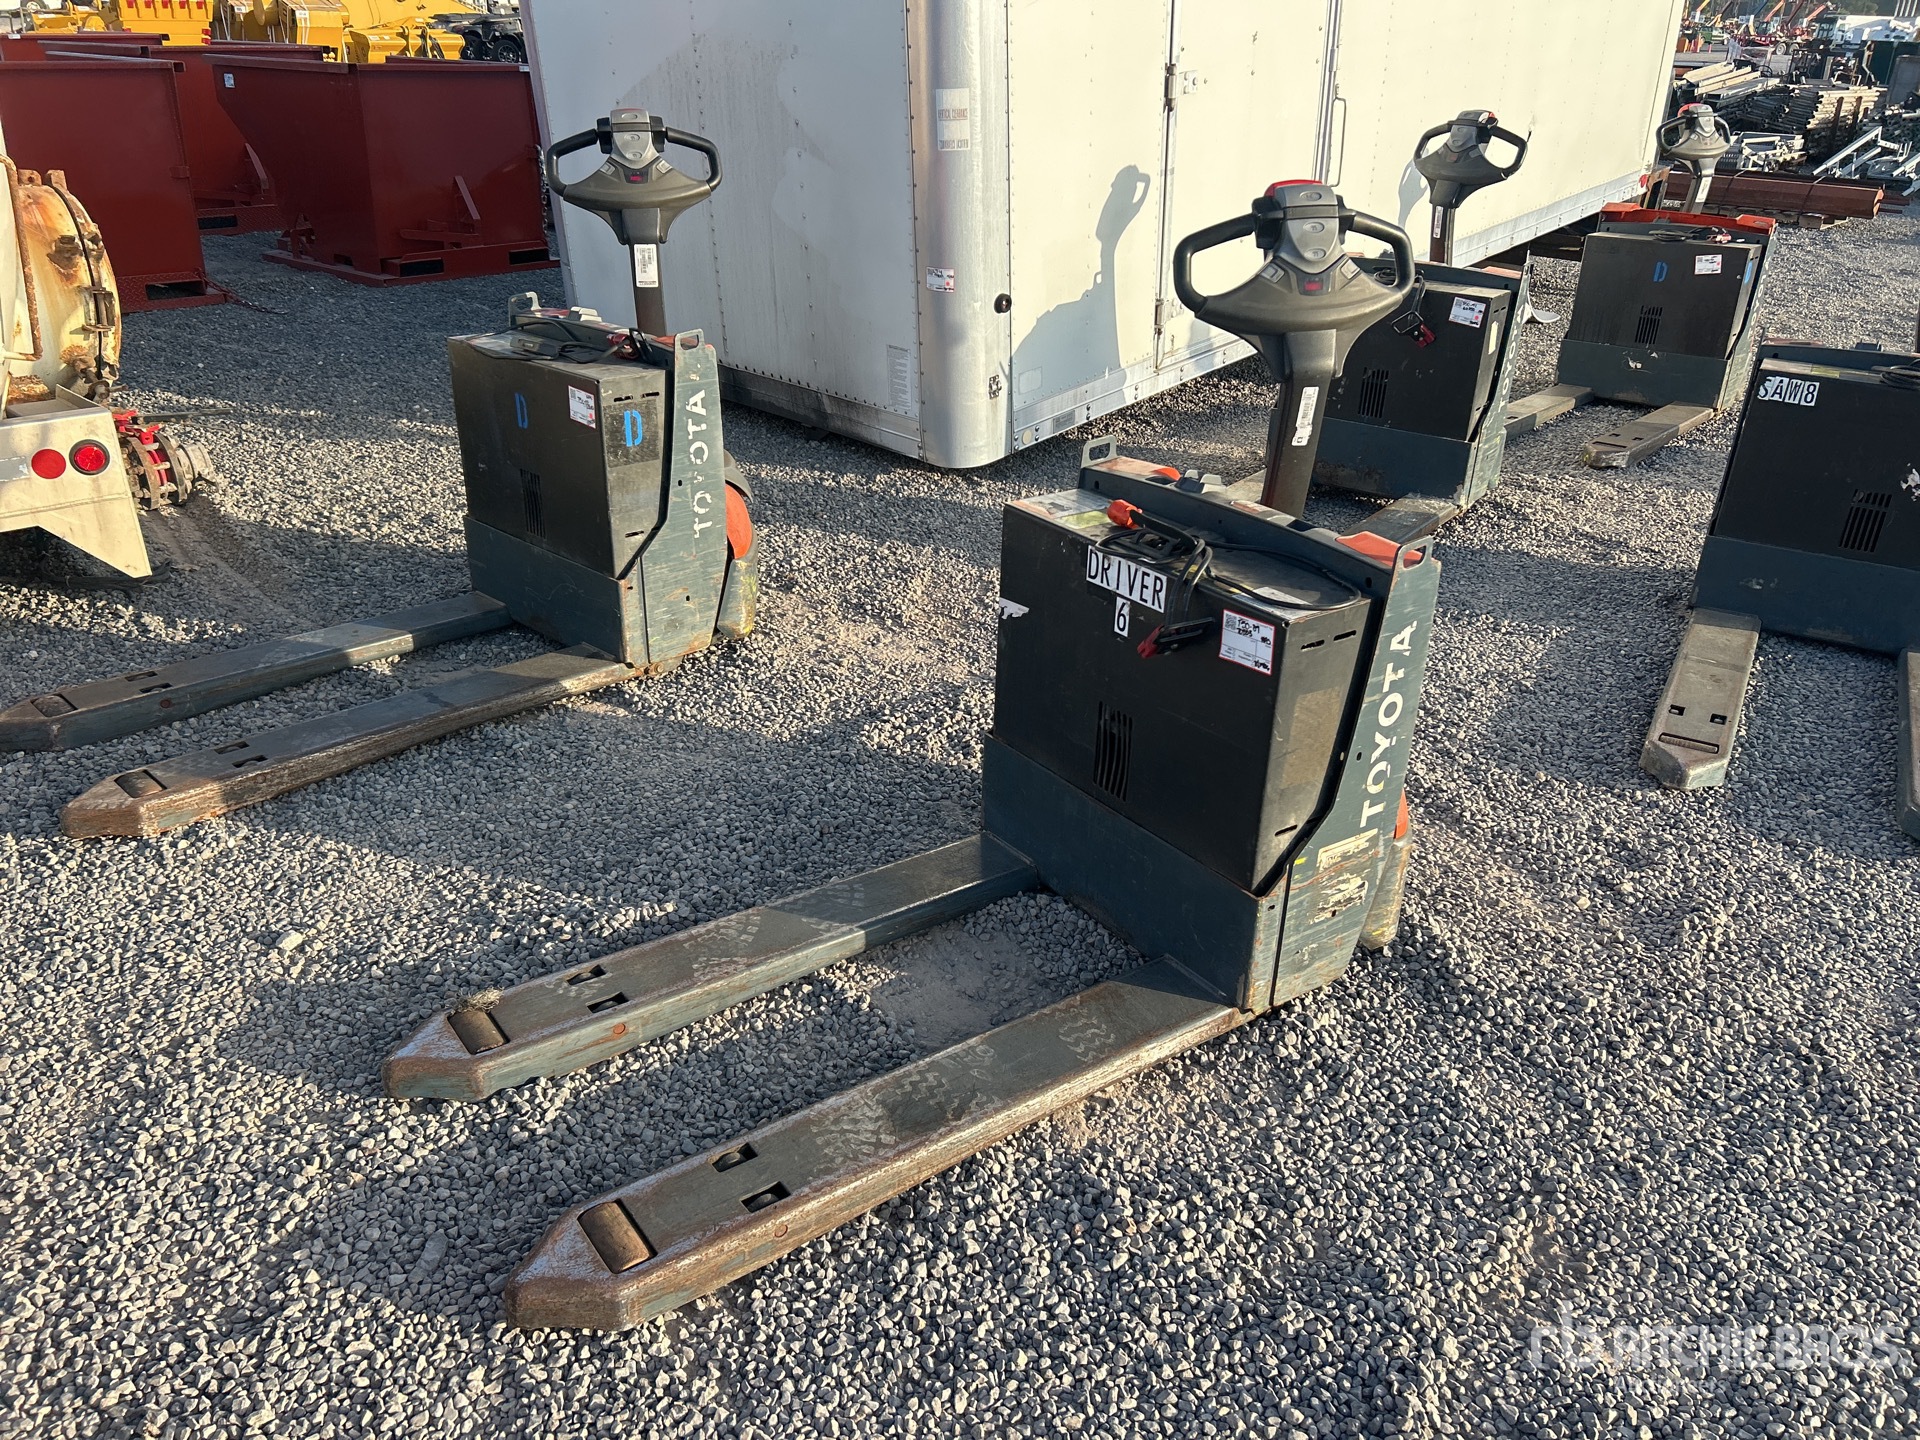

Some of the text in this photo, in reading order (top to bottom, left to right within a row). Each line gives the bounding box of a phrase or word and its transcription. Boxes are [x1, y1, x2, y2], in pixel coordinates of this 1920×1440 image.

[1653, 261, 1668, 282] D
[1758, 377, 1817, 405] SAW8
[515, 392, 529, 429] D
[624, 409, 643, 447] D
[686, 389, 713, 539] TOYOTA
[1087, 548, 1164, 611] DRIVER
[1116, 602, 1128, 633] 6
[1359, 619, 1418, 828] TOYOTA
